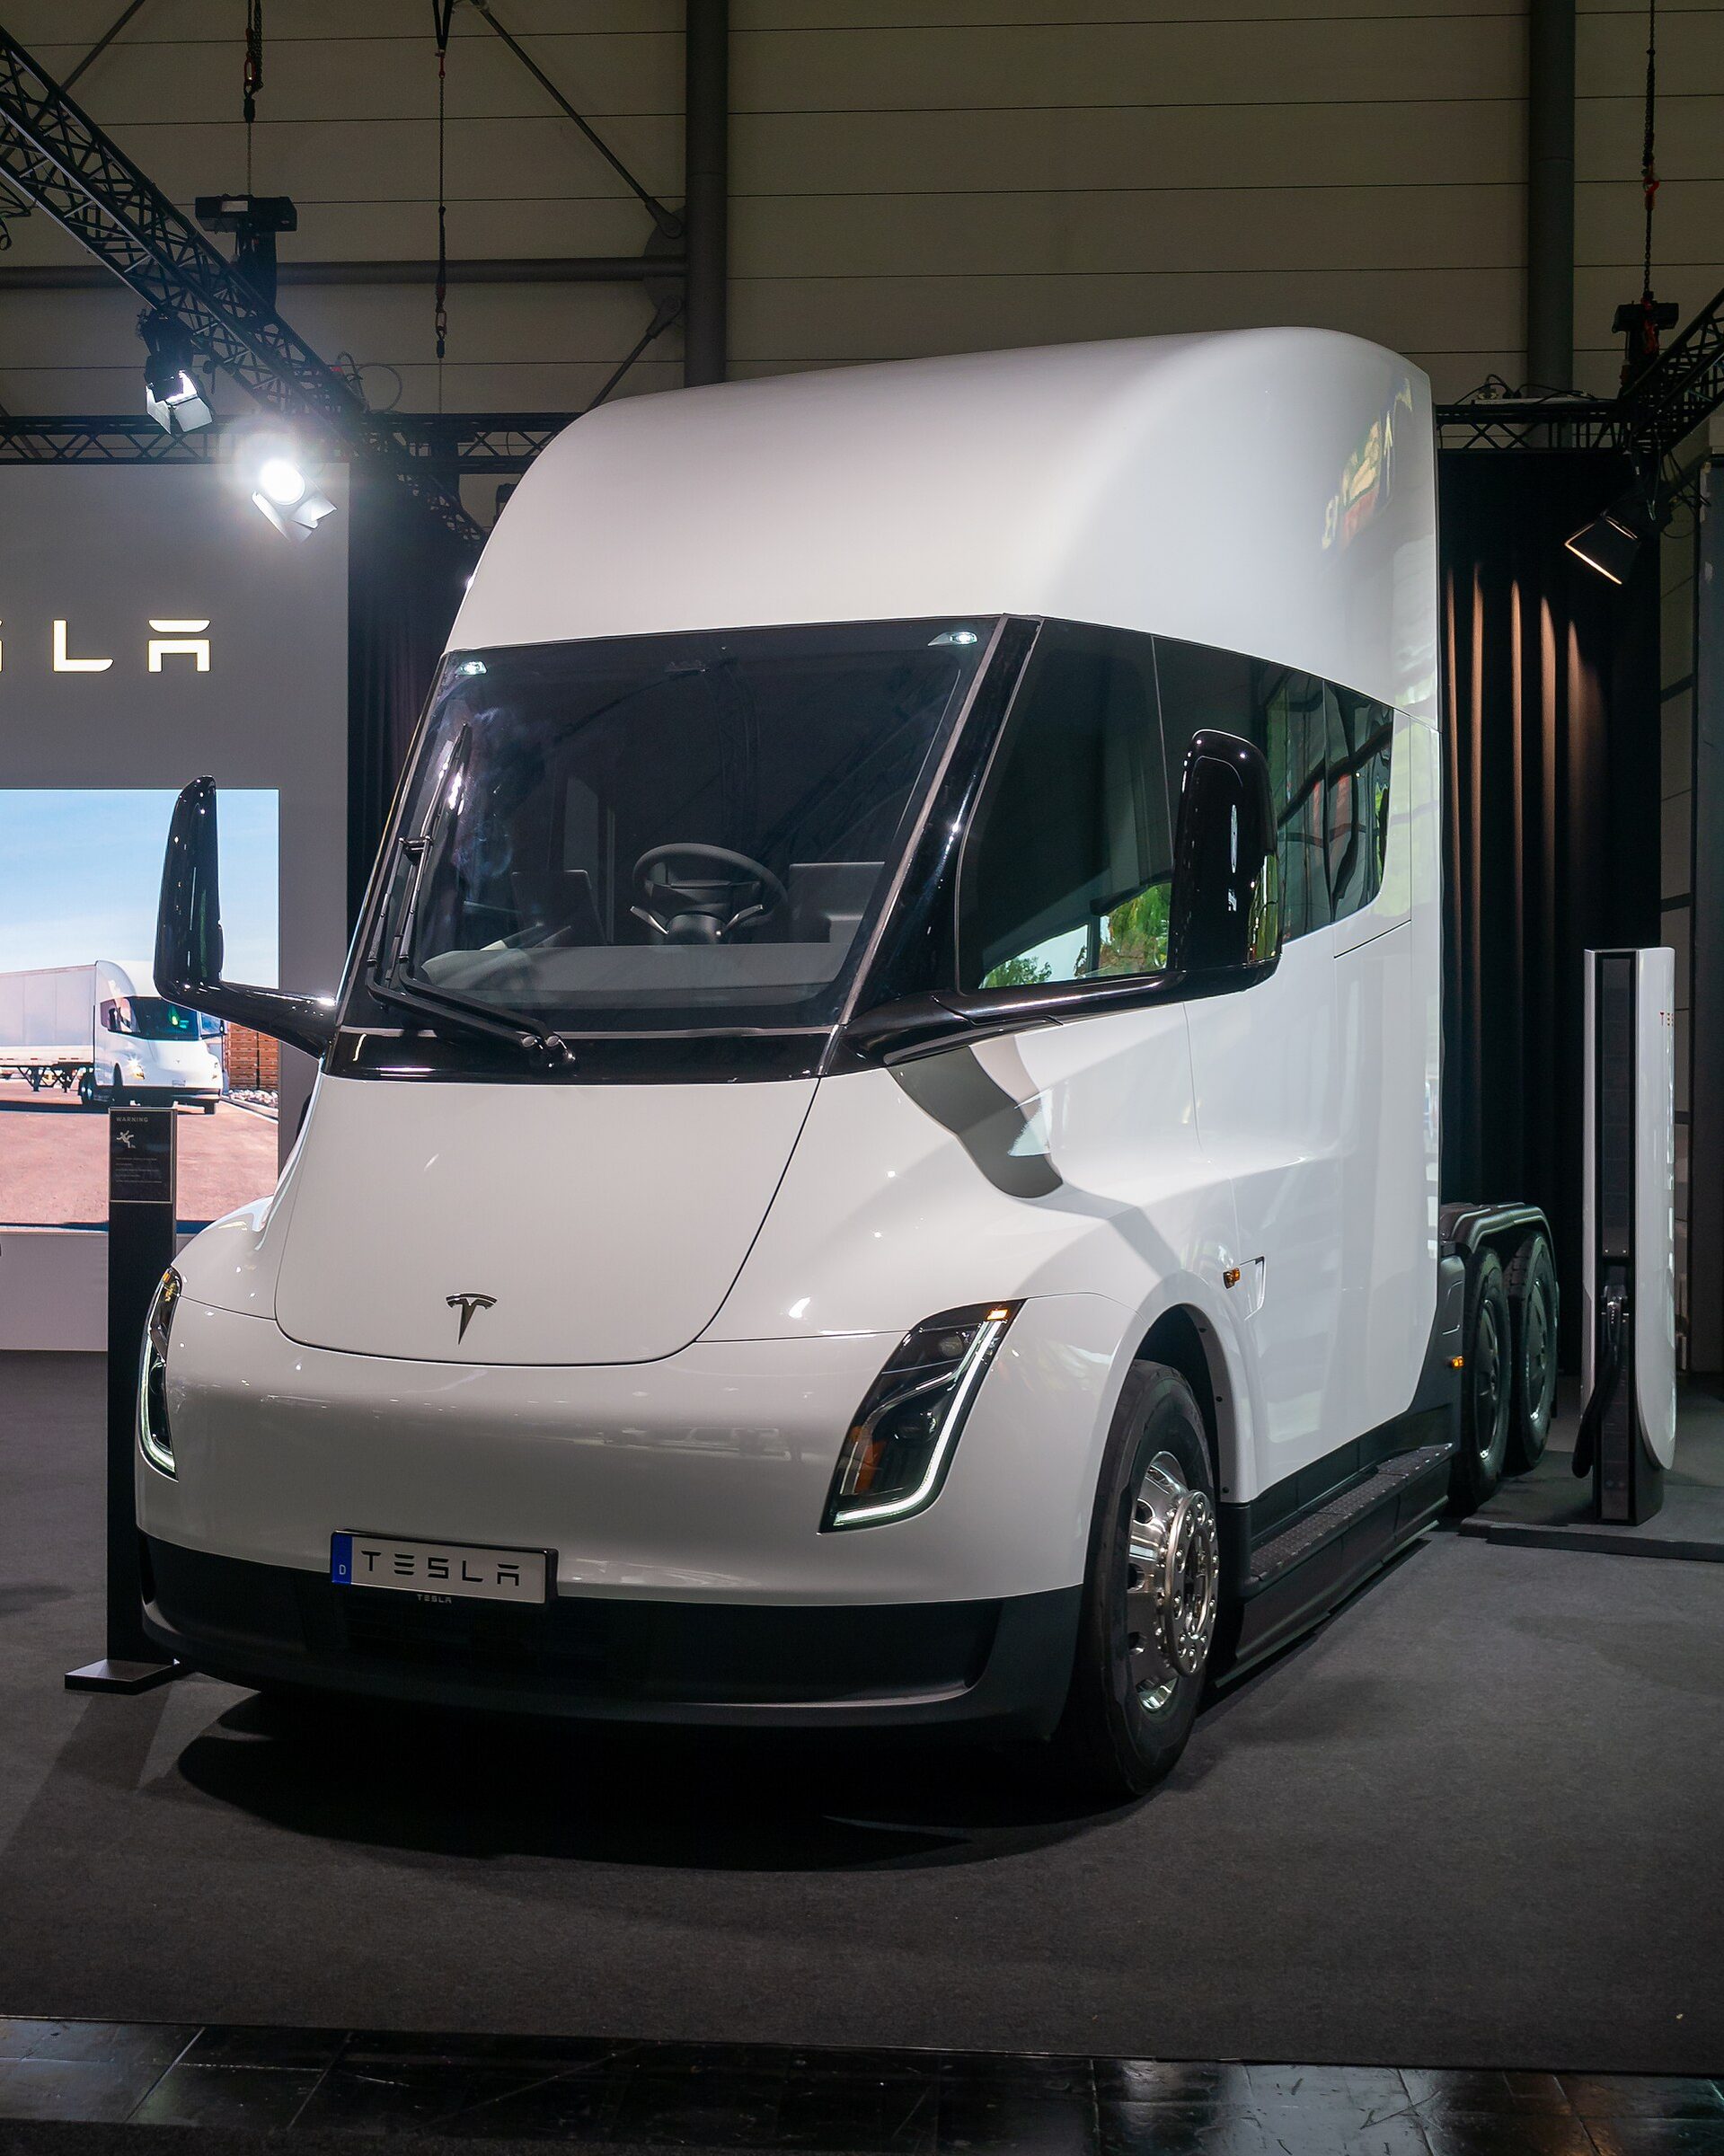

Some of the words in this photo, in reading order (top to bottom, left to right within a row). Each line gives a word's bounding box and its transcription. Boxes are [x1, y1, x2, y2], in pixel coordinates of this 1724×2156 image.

[0, 619, 211, 673] LA
[339, 1564, 347, 1575] D
[361, 1550, 520, 1587] TESLA
[417, 1594, 452, 1604] TESLA
